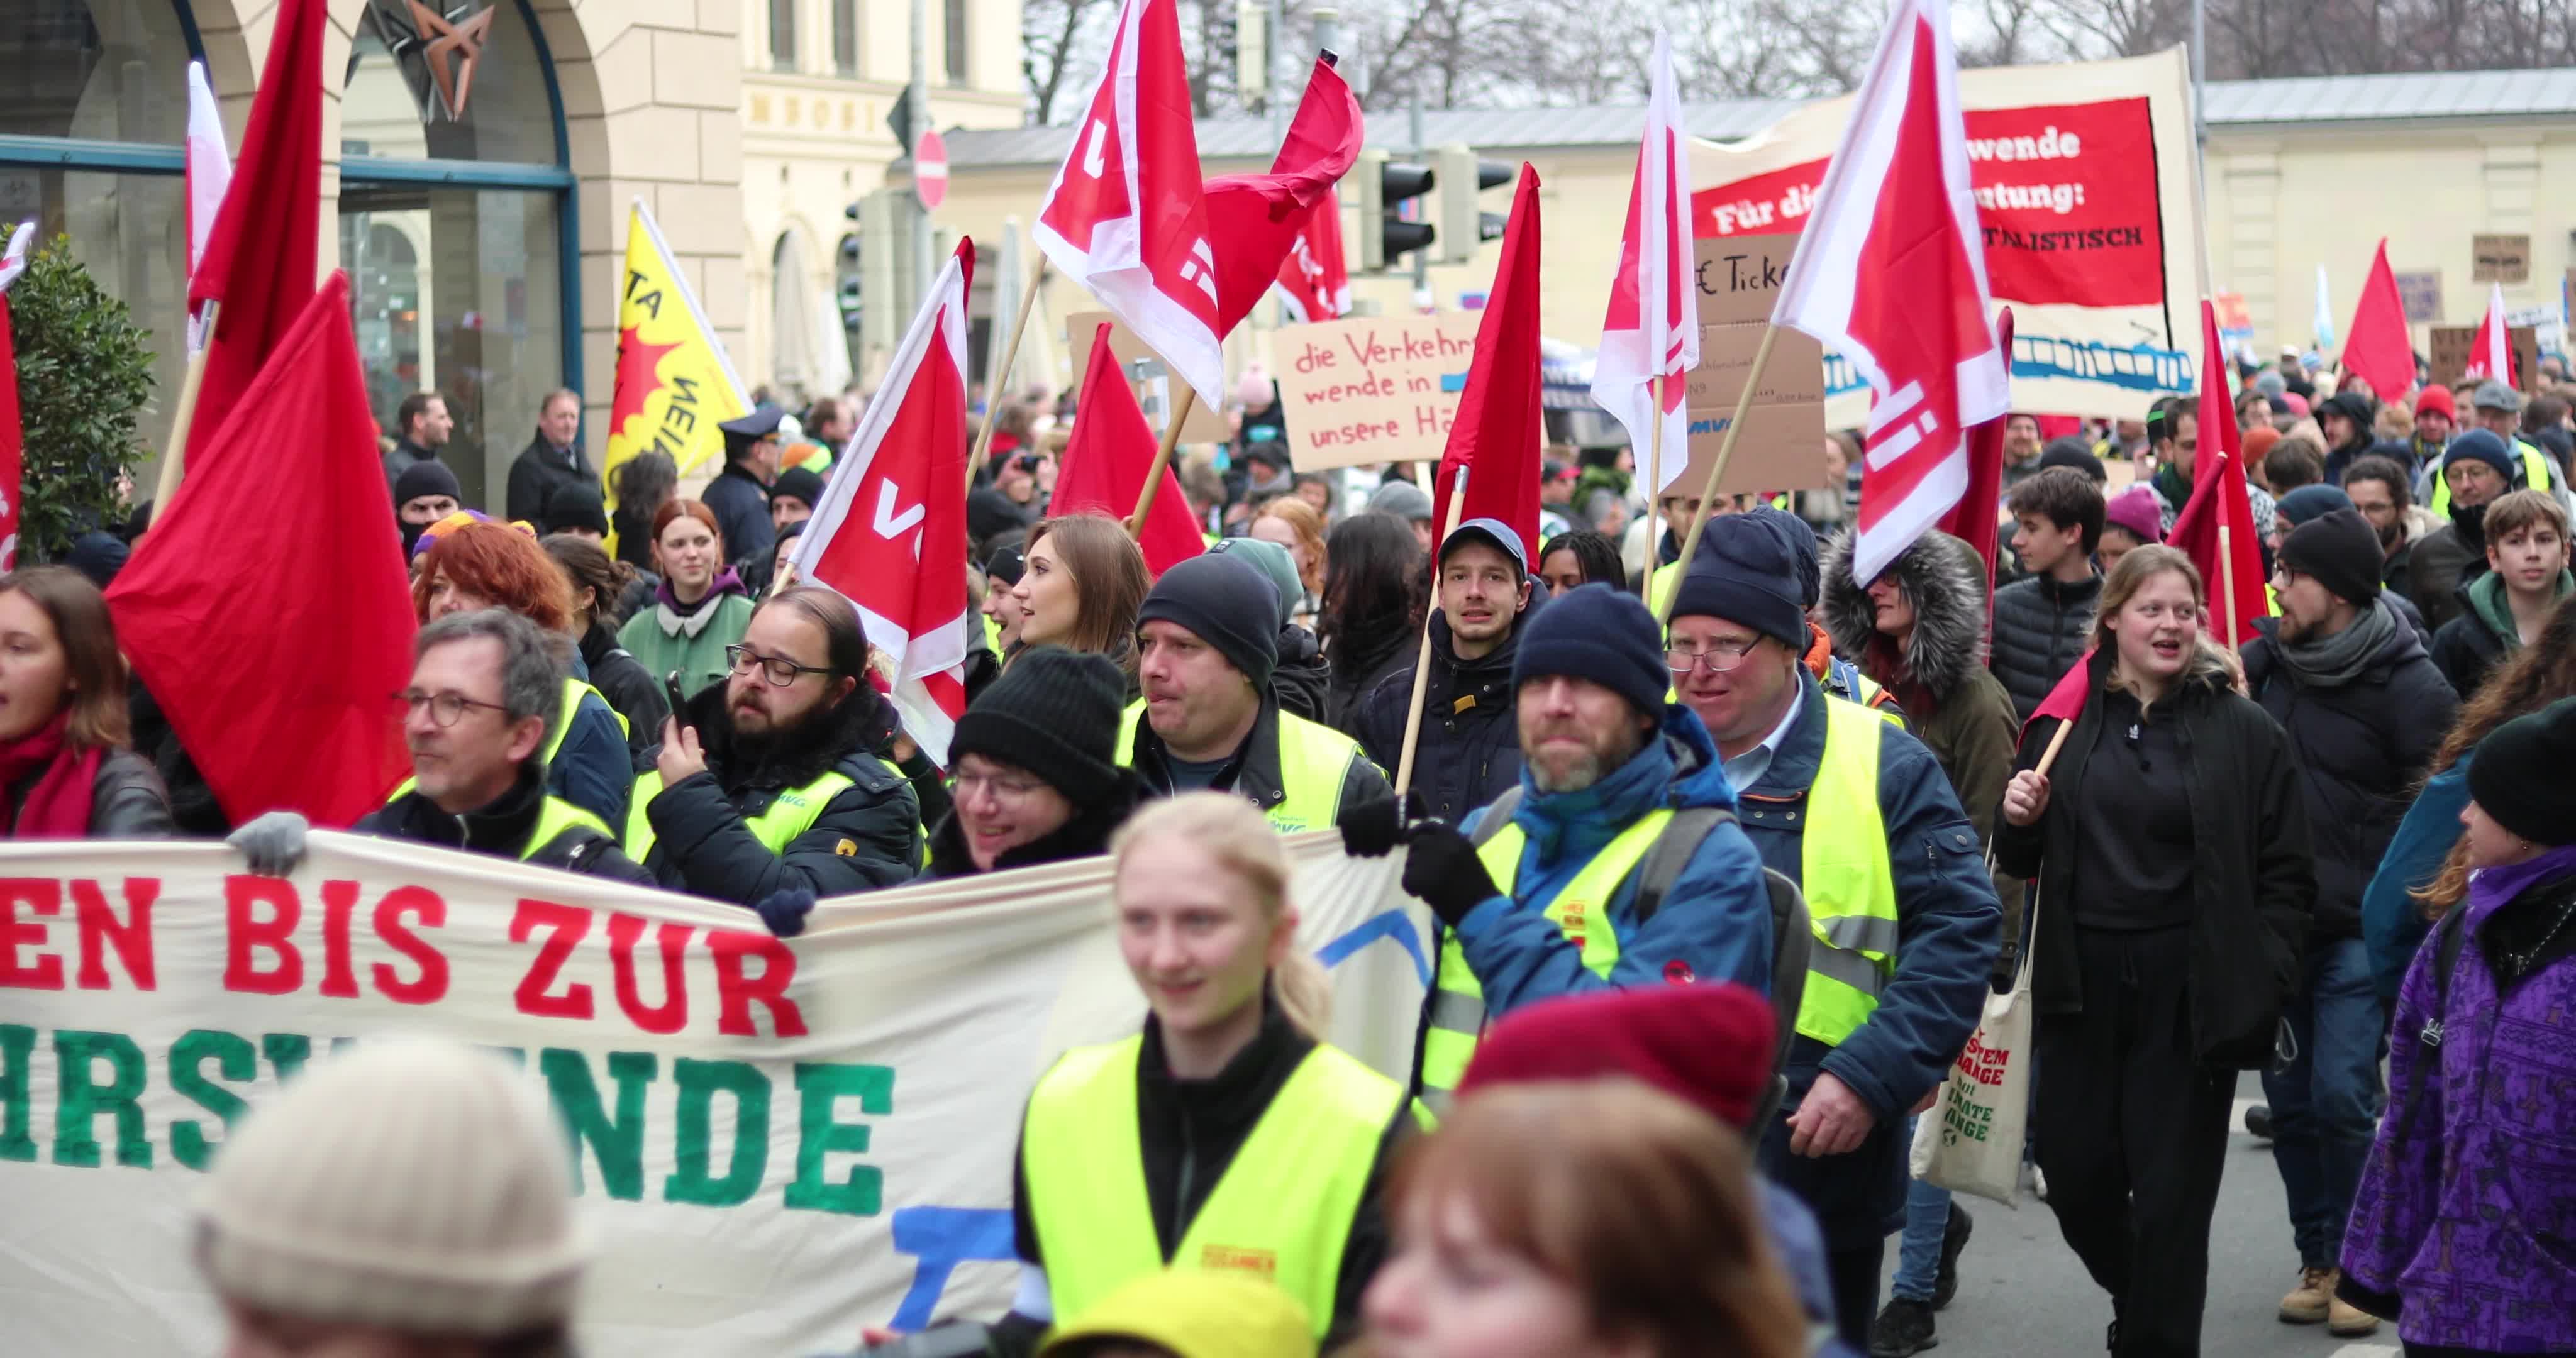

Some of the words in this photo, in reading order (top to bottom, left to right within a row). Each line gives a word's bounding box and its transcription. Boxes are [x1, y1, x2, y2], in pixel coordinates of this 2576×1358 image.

[1711, 199, 1775, 235] Für
[1779, 184, 1824, 219] di
[1296, 343, 1336, 373] die
[1344, 328, 1477, 367] Verkehr
[1304, 370, 1394, 404] wende
[1407, 370, 1431, 392] in
[1310, 420, 1399, 448] unsere
[1687, 418, 1733, 434] MV
[223, 873, 451, 1005] BIS
[509, 898, 809, 1038] ZUR
